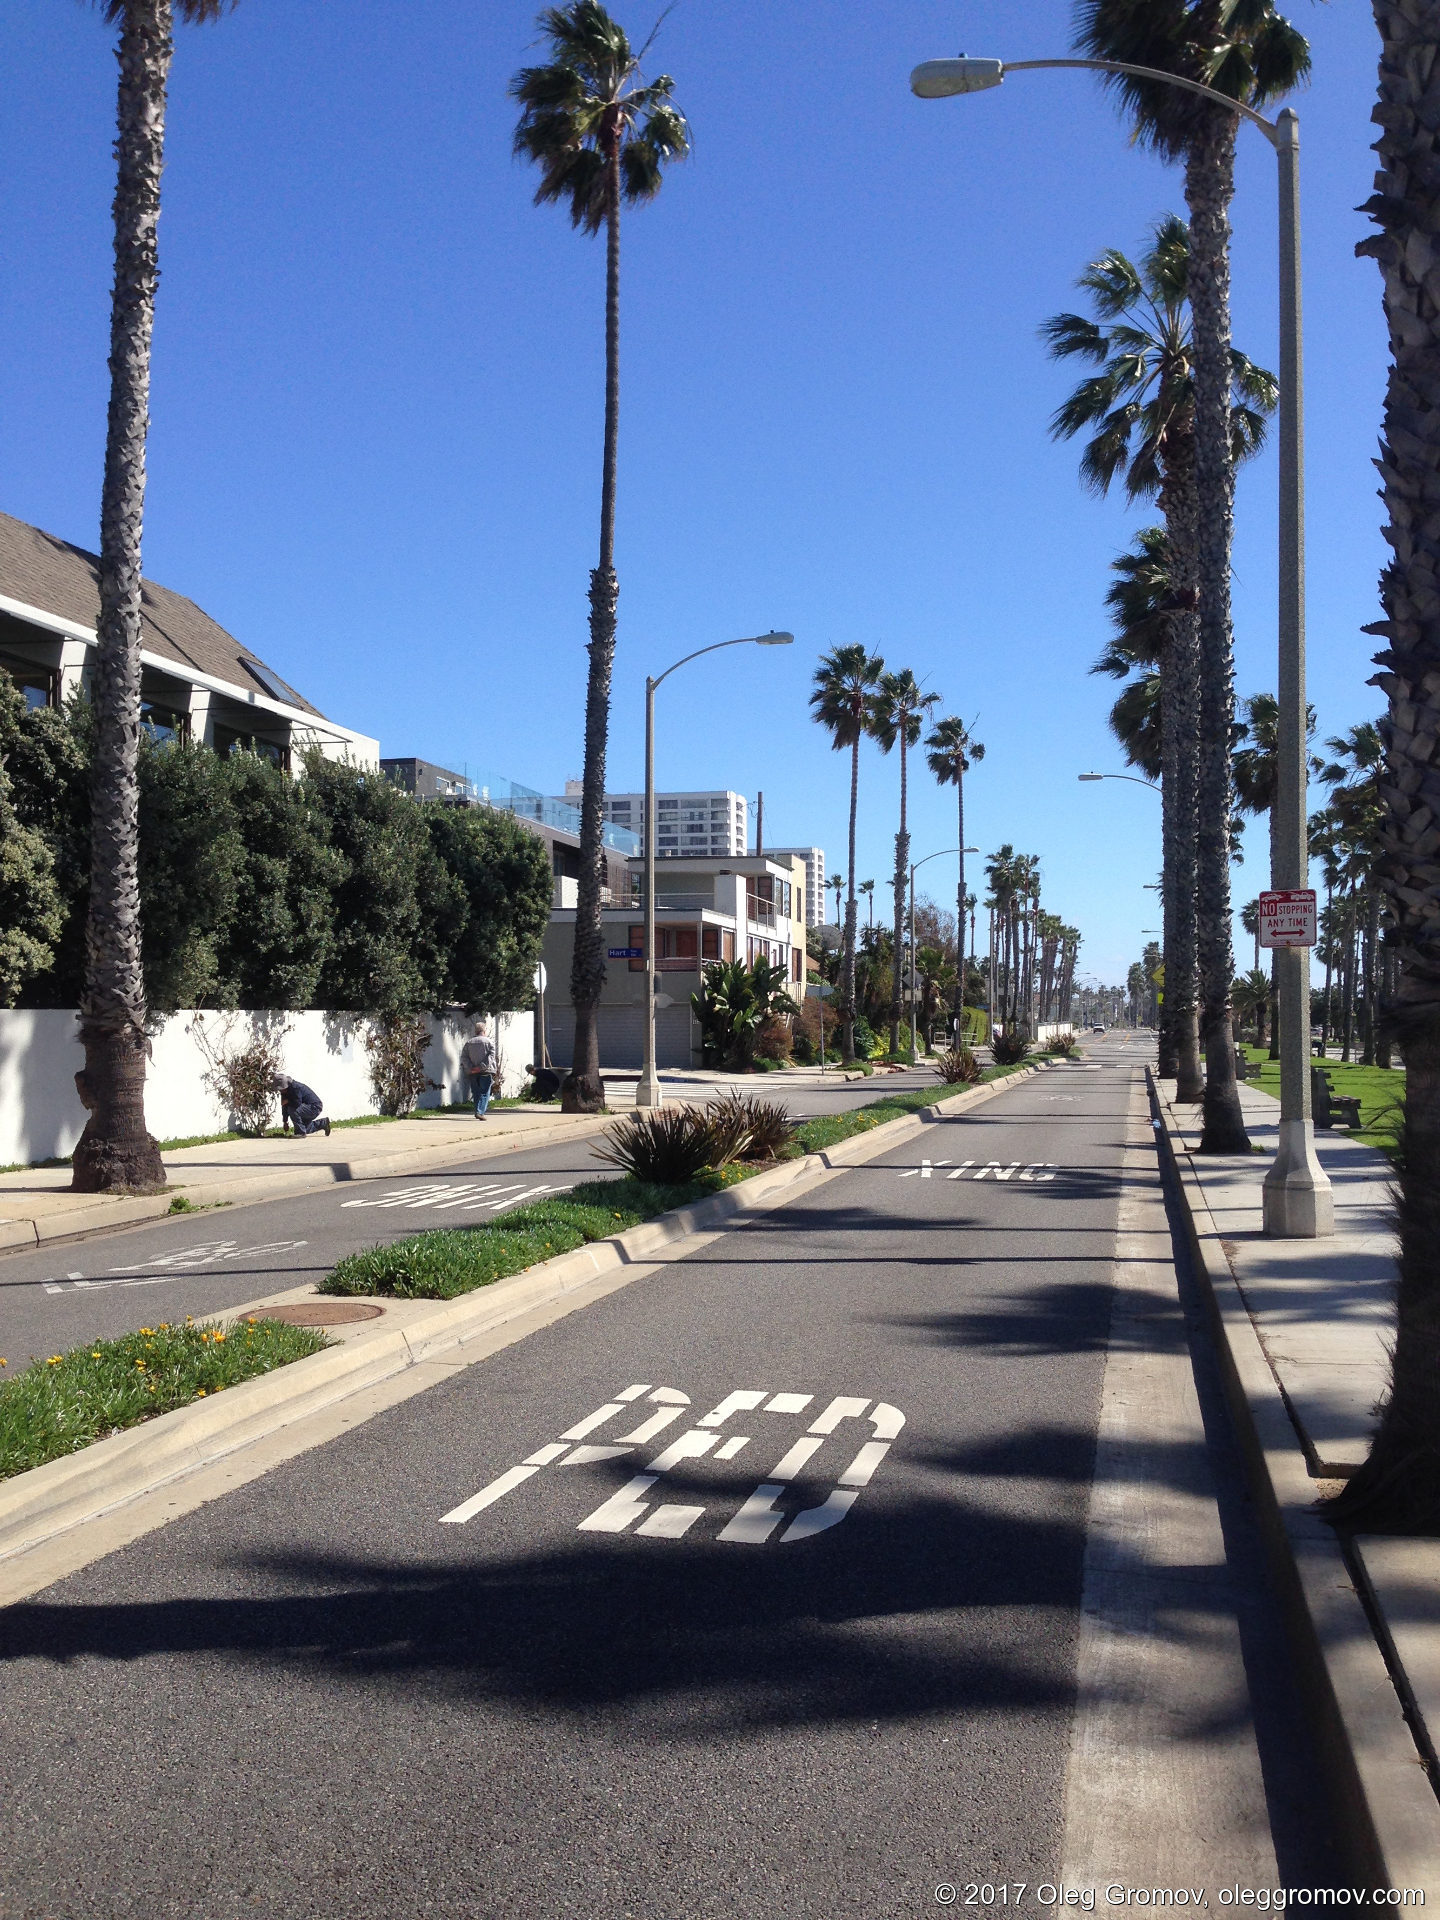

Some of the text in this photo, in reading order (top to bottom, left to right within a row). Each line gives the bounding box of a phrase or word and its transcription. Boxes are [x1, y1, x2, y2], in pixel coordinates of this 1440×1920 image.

[1261, 903, 1313, 916] NO STOPPING
[1267, 917, 1308, 928] ANY TIME
[897, 1159, 1059, 1182] XING
[438, 1384, 908, 1544] PED
